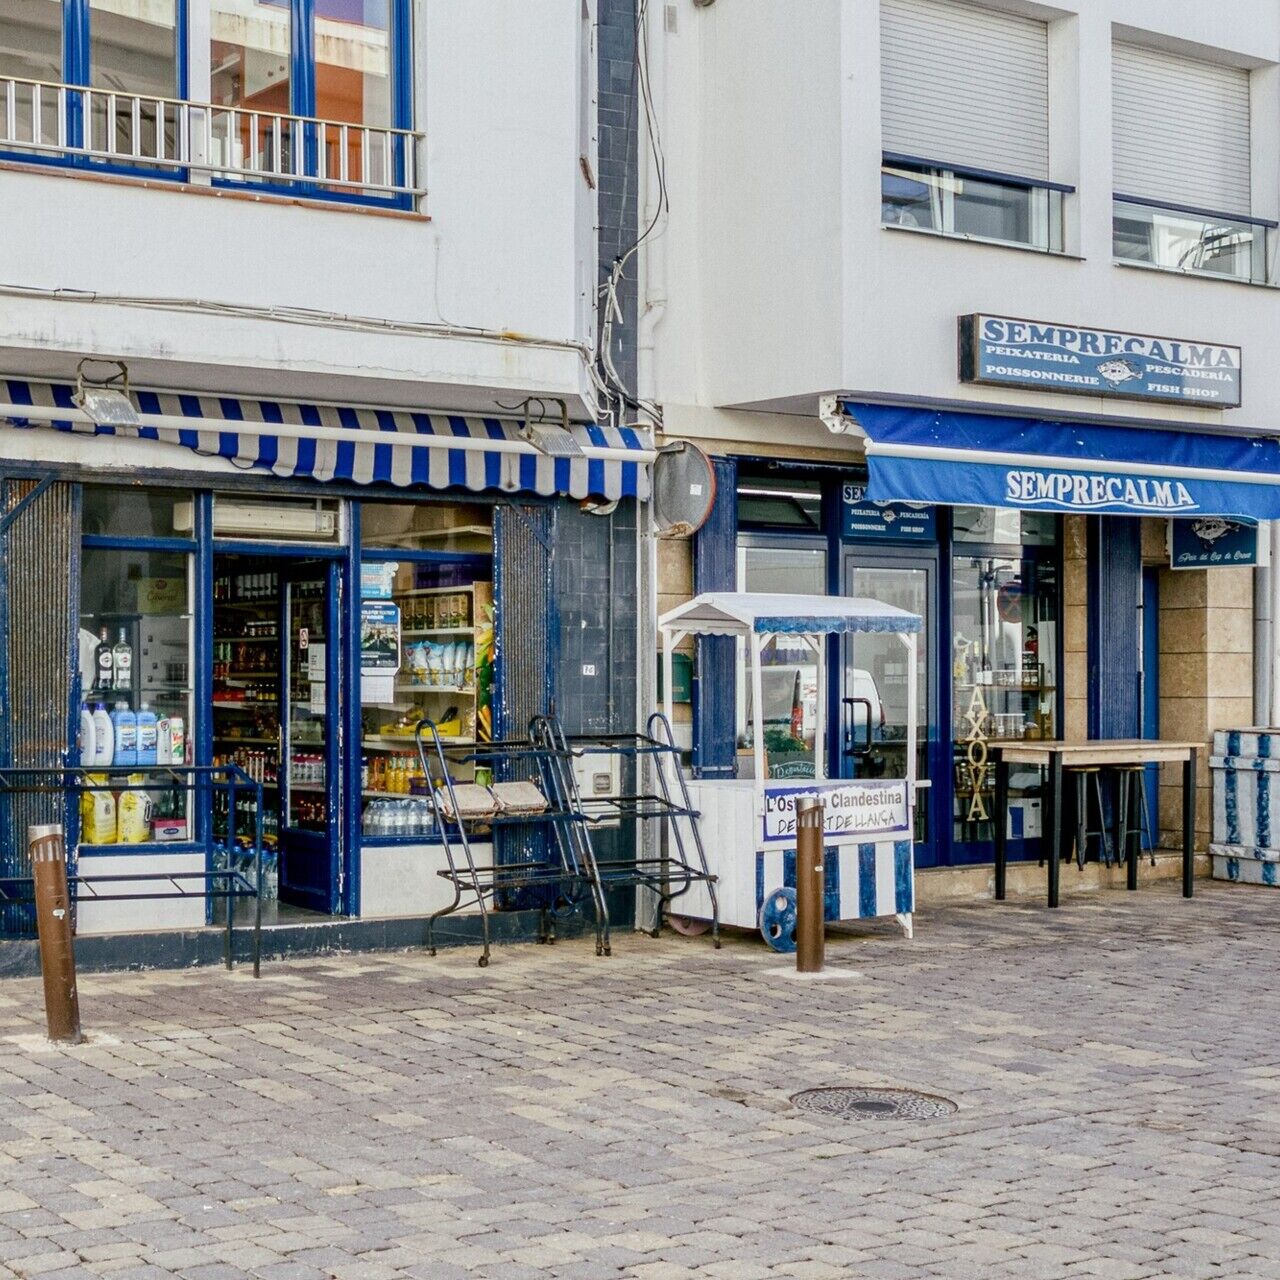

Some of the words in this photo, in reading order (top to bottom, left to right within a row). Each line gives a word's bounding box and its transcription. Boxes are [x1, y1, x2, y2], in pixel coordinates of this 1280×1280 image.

[983, 320, 1235, 368] SEMPRECALMA
[985, 345, 1080, 364] PEIXATERIA
[985, 365, 1100, 386] POISSONNERIE
[1145, 364, 1233, 382] PESCADERÍA
[1147, 383, 1181, 395] FISH
[1183, 386, 1220, 398] SHOP
[1006, 471, 1195, 508] SEMPRECALMA
[831, 791, 902, 809] Clandestina
